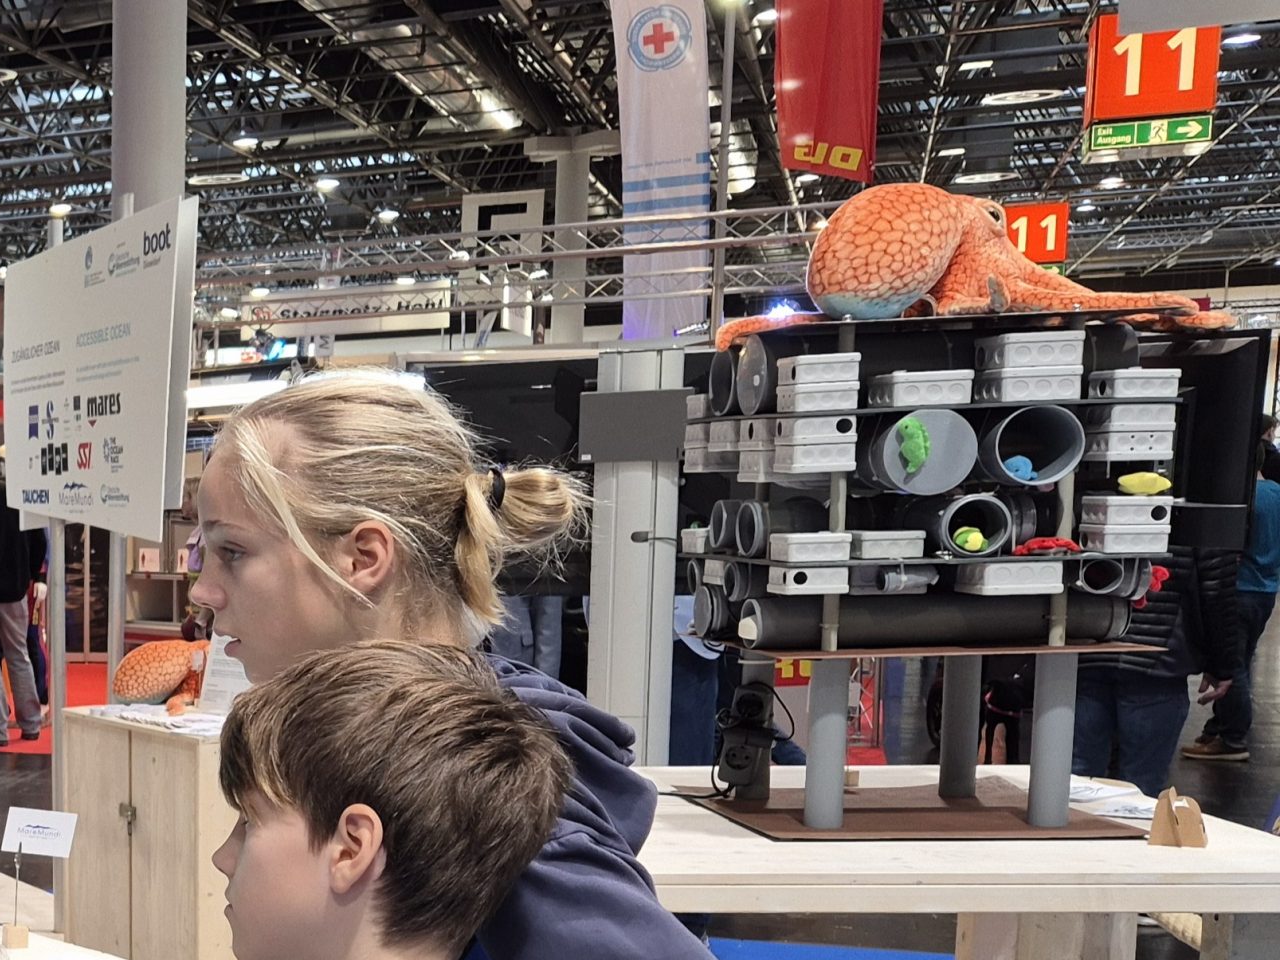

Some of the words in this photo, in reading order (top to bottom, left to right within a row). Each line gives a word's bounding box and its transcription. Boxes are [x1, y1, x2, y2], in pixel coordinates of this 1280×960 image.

[1114, 27, 1198, 97] 11
[1096, 135, 1132, 145] Ausgang
[1097, 127, 1113, 136] Exit
[143, 222, 171, 257] boot
[1011, 214, 1057, 253] 11
[86, 392, 121, 418] mares
[77, 442, 92, 470] SSI
[22, 489, 50, 505] TAUCHEN
